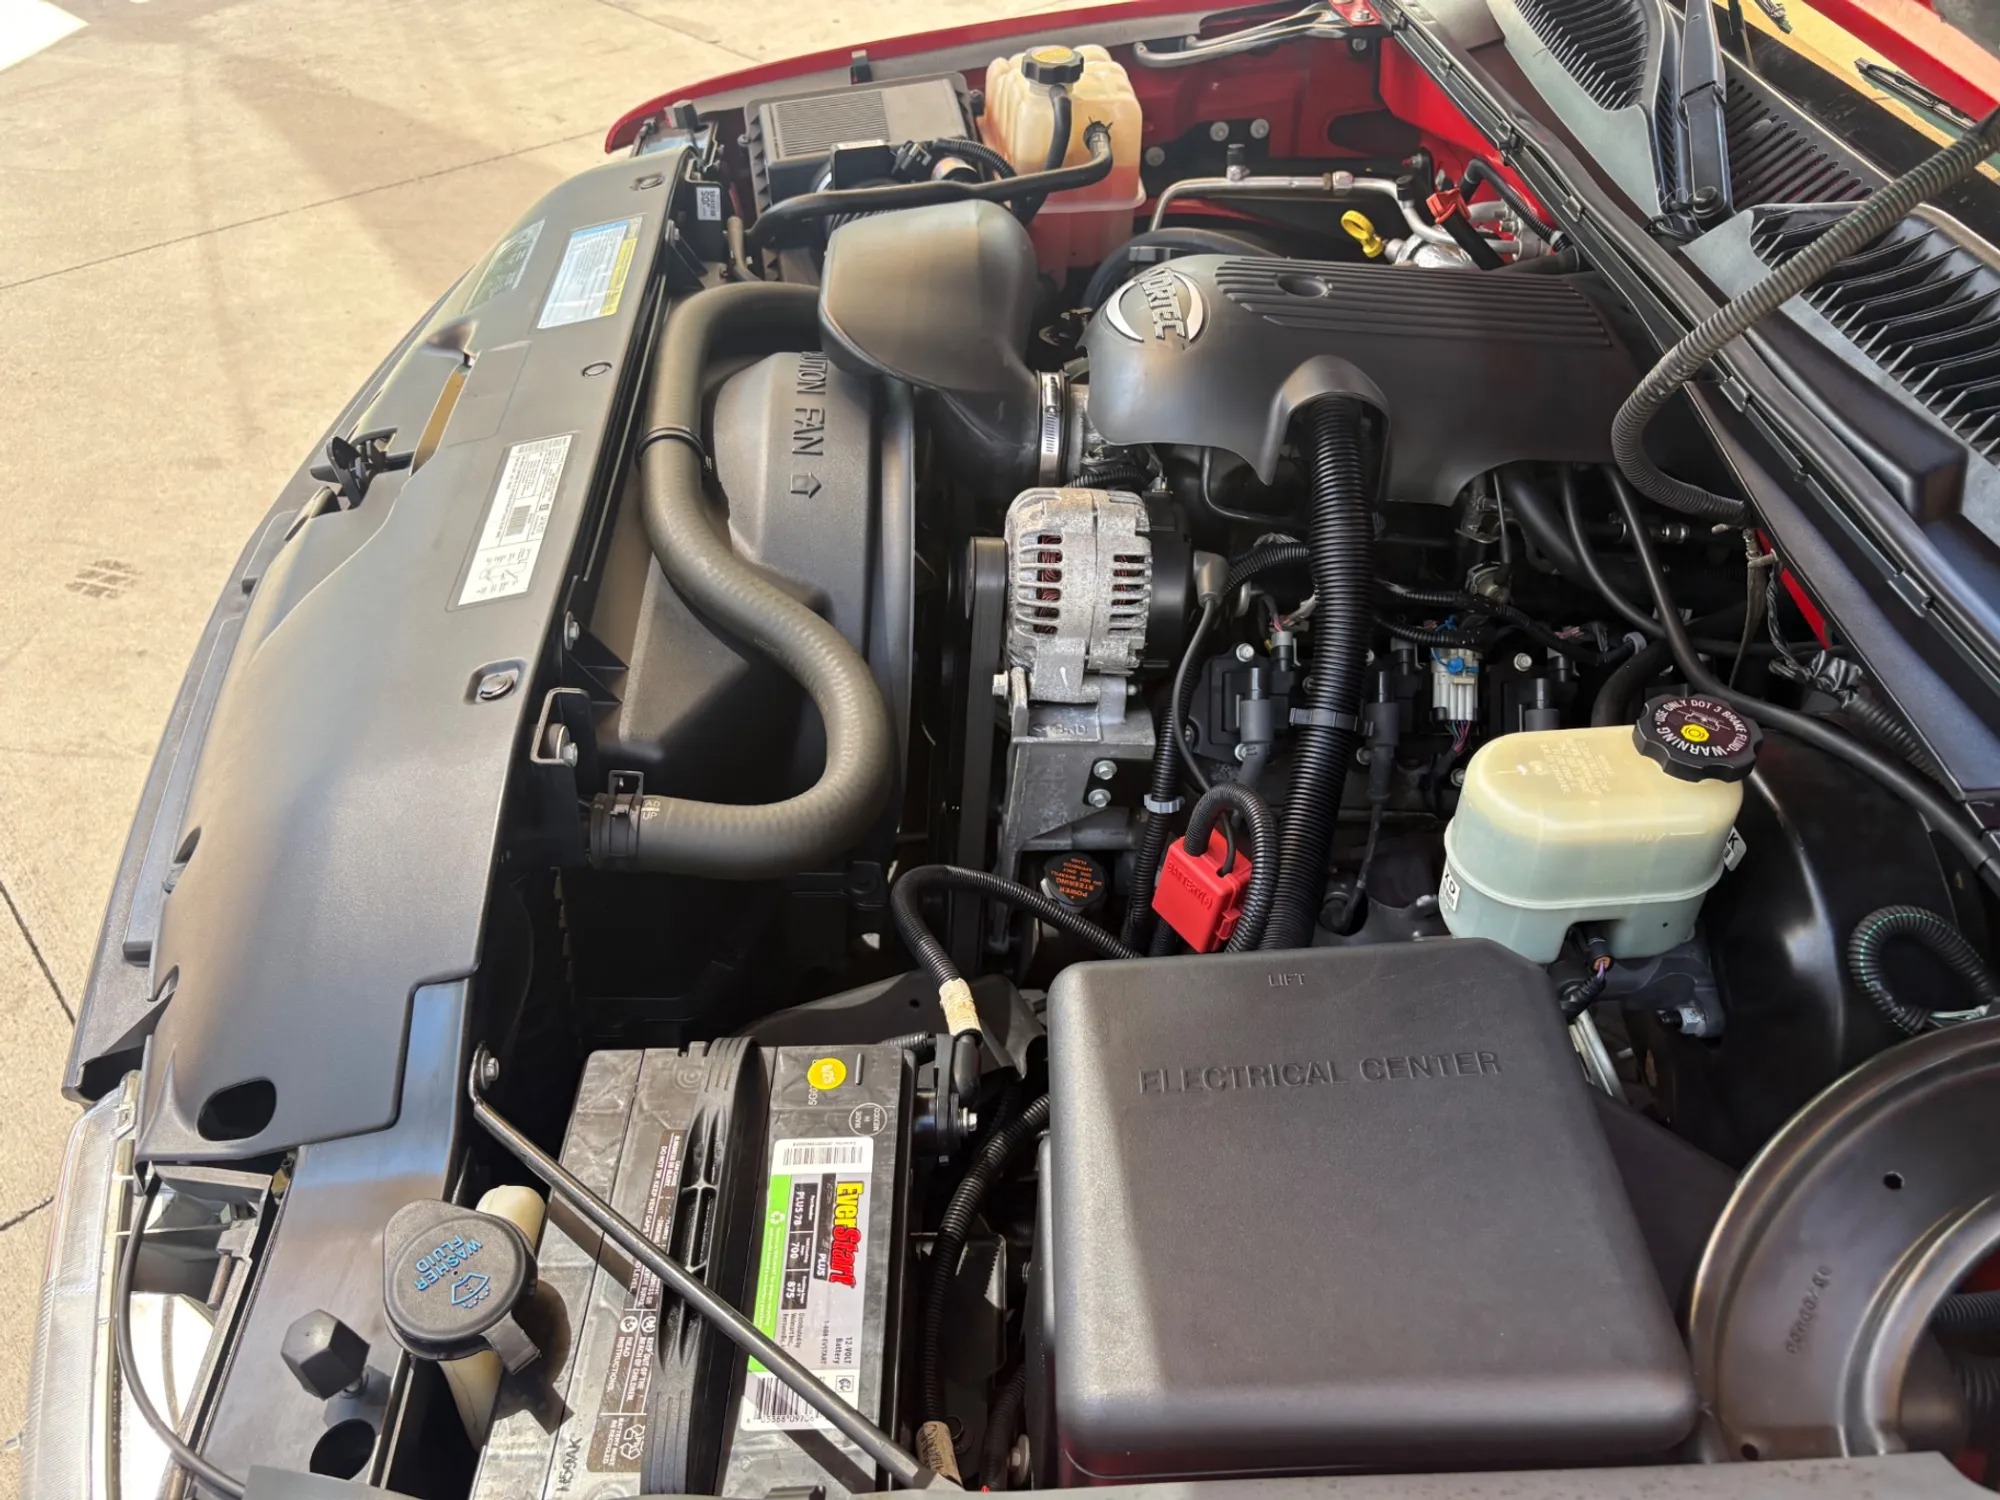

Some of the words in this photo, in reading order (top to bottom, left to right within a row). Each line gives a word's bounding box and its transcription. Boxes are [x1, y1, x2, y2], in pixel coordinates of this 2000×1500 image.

[792, 408, 825, 456] FAN
[1662, 699, 1687, 712] ONLY
[1690, 699, 1711, 710] DOT
[1713, 705, 1722, 713] 3
[1654, 710, 1669, 724] USE
[1721, 711, 1748, 733] BRAKE
[1656, 727, 1728, 757] WARNING
[1728, 733, 1748, 752] FLUID
[1055, 877, 1093, 890] STEERING
[1059, 886, 1087, 897] POWER
[1268, 973, 1305, 987] LIFT
[1139, 1060, 1348, 1095] ELECTRICAL
[1359, 1050, 1502, 1082] CENTER
[872, 1107, 880, 1130] MEXICO
[661, 1145, 667, 1155] DO
[794, 1191, 804, 1212] PLUS
[644, 1214, 652, 1232] CAPS
[793, 1214, 802, 1225] 78
[829, 1179, 865, 1286] EverStart
[416, 1235, 464, 1272] FLUID
[789, 1241, 799, 1258] 700
[414, 1239, 483, 1291] WASHER
[817, 1252, 825, 1276] PLUS
[785, 1280, 795, 1298] 875
[623, 1336, 632, 1356] READ
[834, 1337, 842, 1364] Battery
[844, 1336, 852, 1363] 12-VOLT
